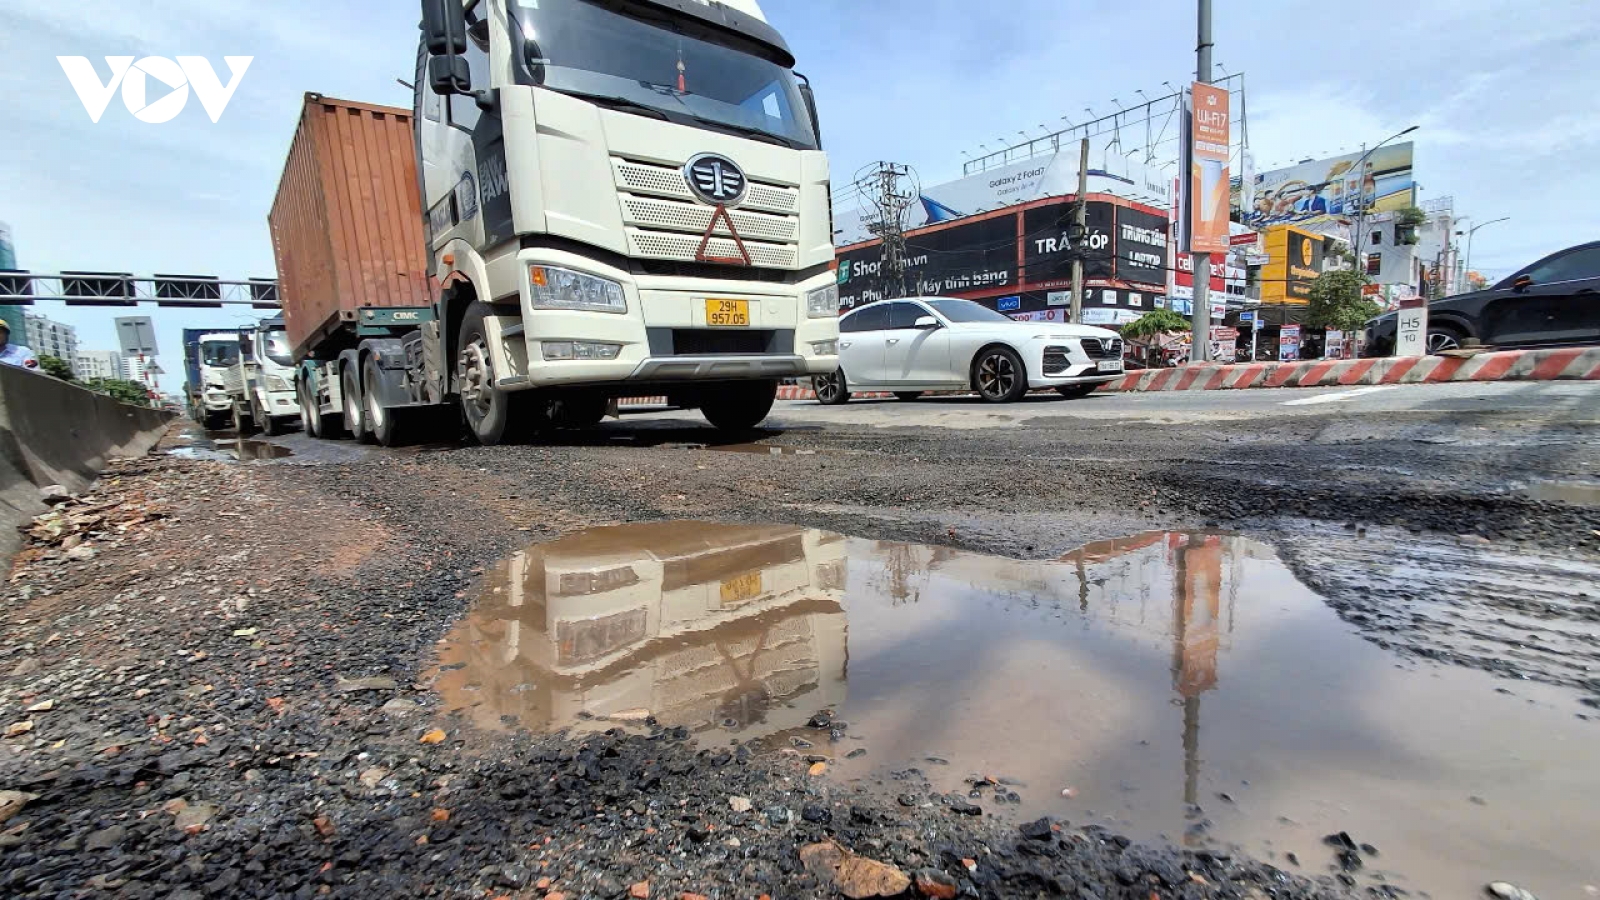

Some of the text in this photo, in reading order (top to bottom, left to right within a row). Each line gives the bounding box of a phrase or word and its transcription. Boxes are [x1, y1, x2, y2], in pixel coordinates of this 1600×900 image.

[481, 172, 508, 204] FAW
[989, 178, 1015, 189] Galaxy
[719, 301, 737, 312] 29H
[393, 311, 419, 320] CIMC
[712, 313, 746, 325] 957.05
[1400, 318, 1420, 329] H5
[1404, 334, 1416, 342] 10
